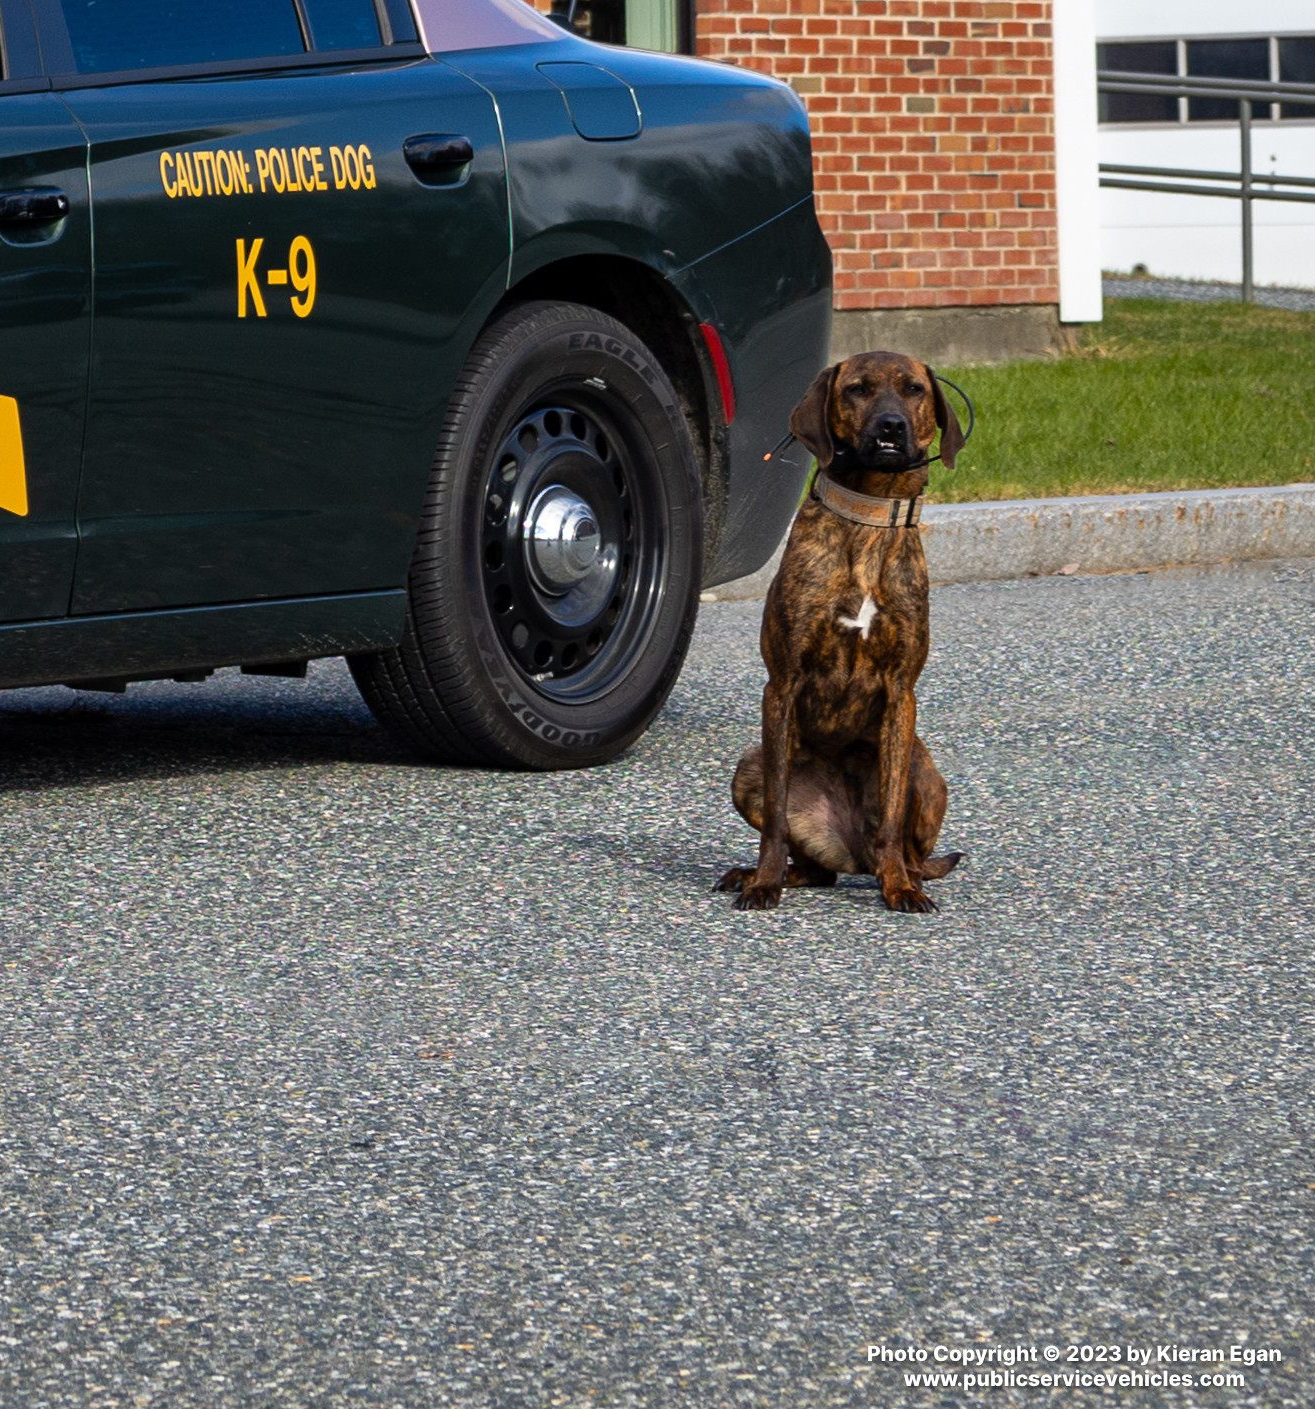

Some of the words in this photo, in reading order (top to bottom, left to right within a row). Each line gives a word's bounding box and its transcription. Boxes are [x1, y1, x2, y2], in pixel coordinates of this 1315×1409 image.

[160, 150, 253, 198] CAUTION:
[255, 146, 328, 193] POLICE
[330, 144, 376, 190] DOG
[236, 235, 316, 318] K-9
[568, 333, 658, 385] EAGLE
